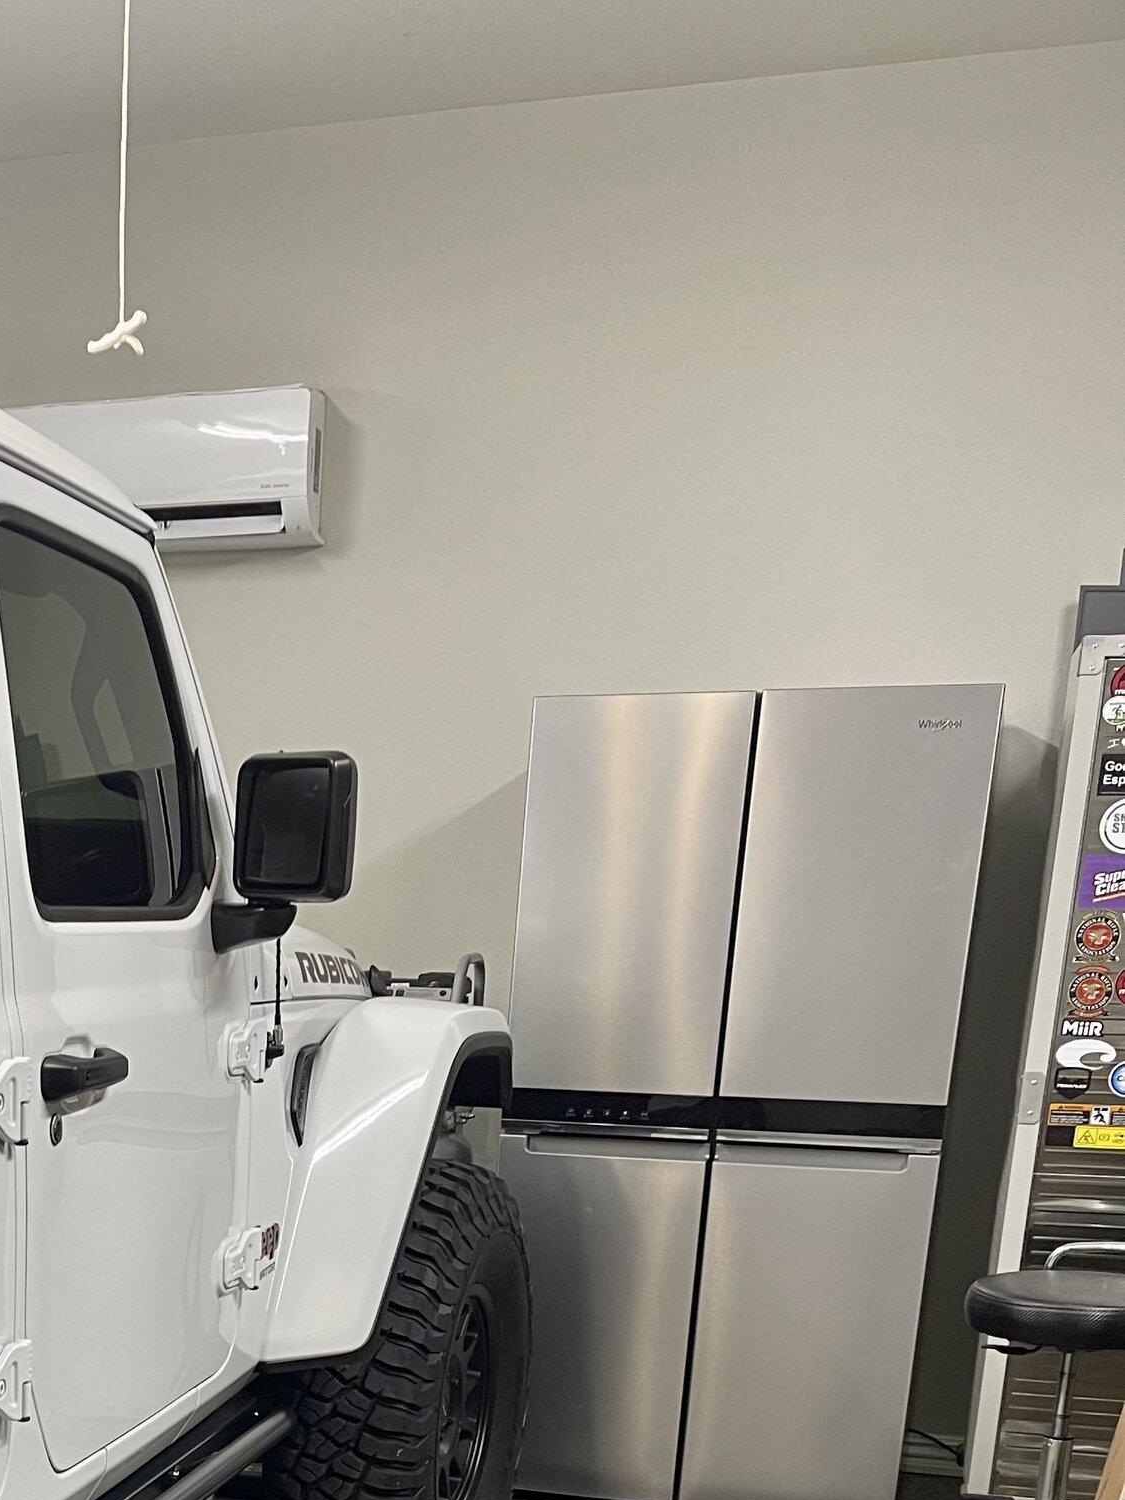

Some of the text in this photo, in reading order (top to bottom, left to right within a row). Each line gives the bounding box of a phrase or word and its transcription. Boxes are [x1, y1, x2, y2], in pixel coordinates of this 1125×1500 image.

[918, 718, 962, 733] Whirlpool
[1077, 917, 1119, 938] NATIONAL RIFLE
[1061, 1020, 1103, 1037] MiiR
